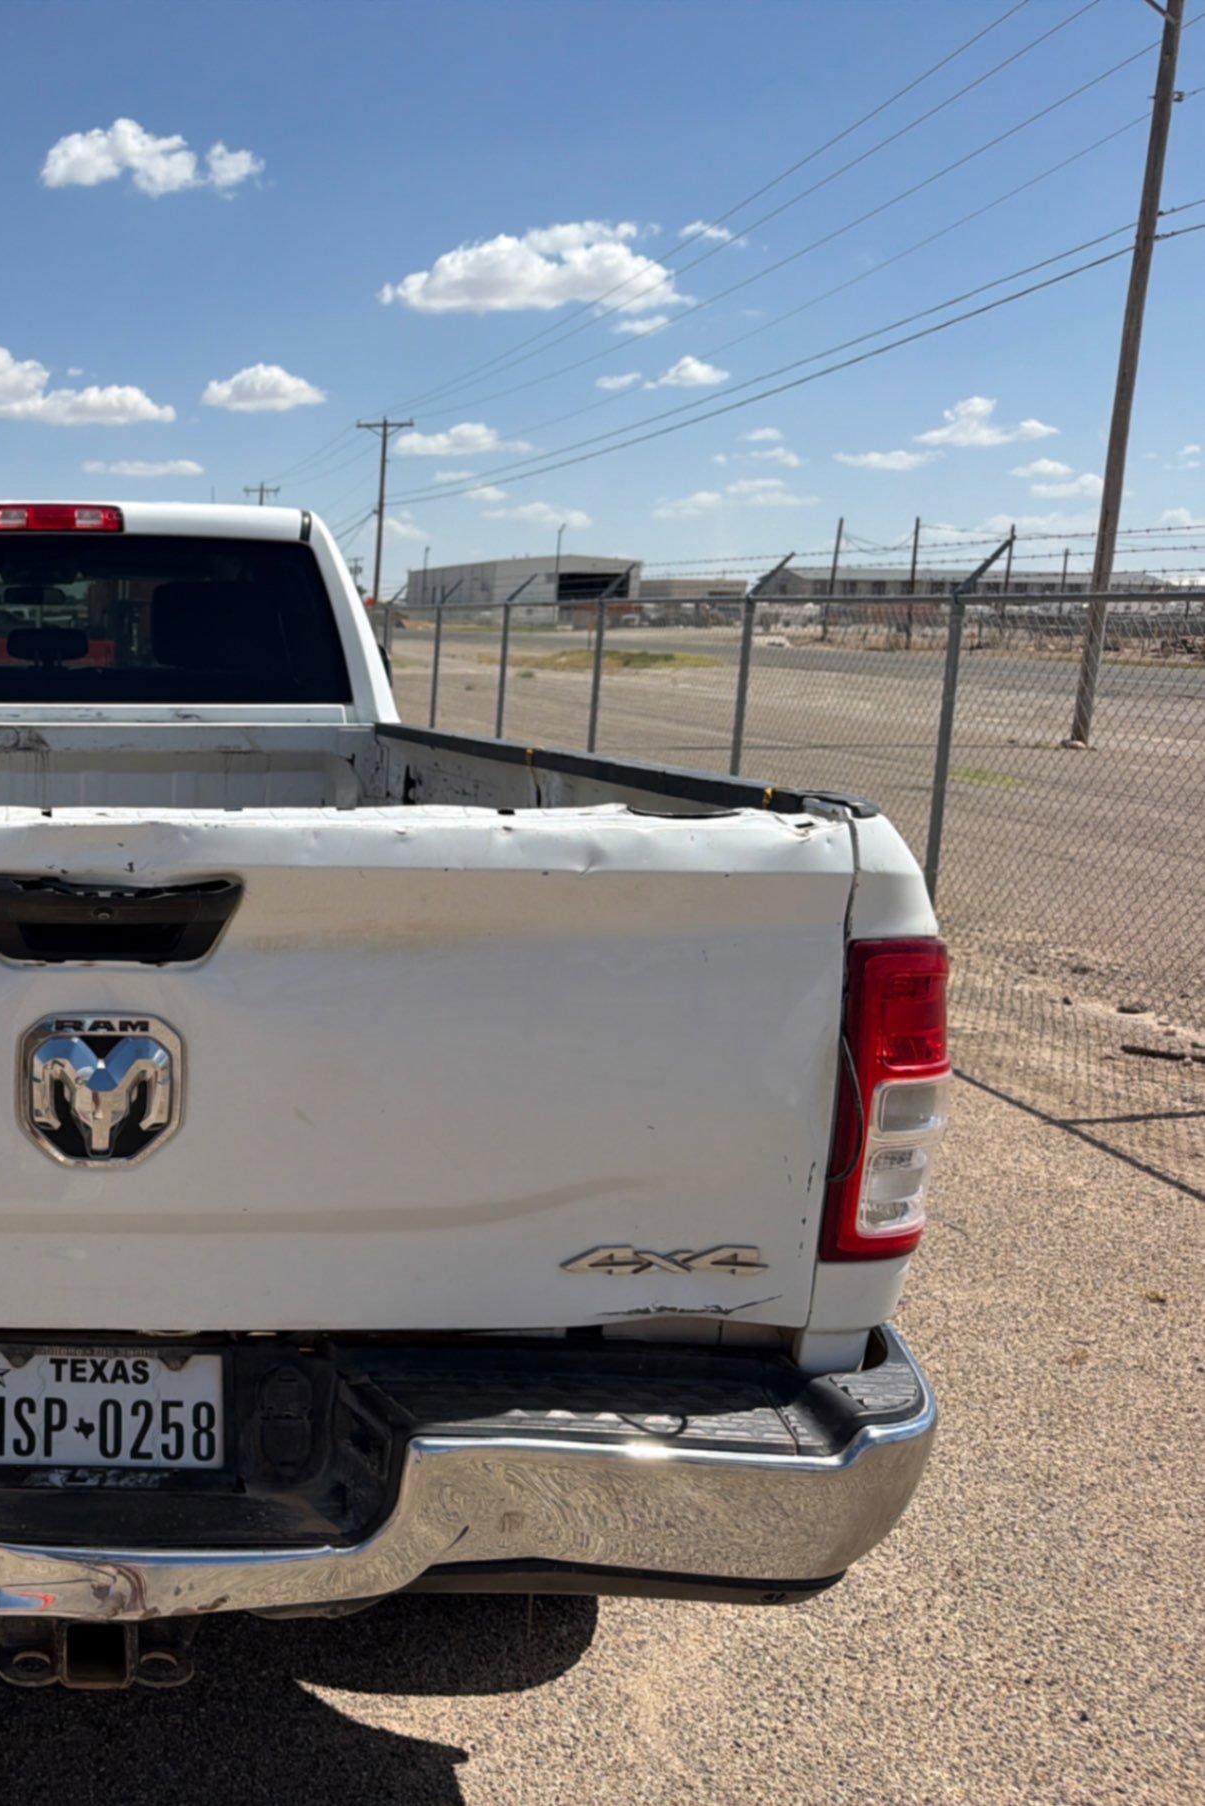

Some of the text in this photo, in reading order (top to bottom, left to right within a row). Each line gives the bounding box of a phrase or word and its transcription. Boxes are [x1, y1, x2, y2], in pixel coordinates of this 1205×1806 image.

[55, 1020, 149, 1032] RAM
[50, 1358, 150, 1384] TEXAS
[99, 1399, 215, 1461] 0258
